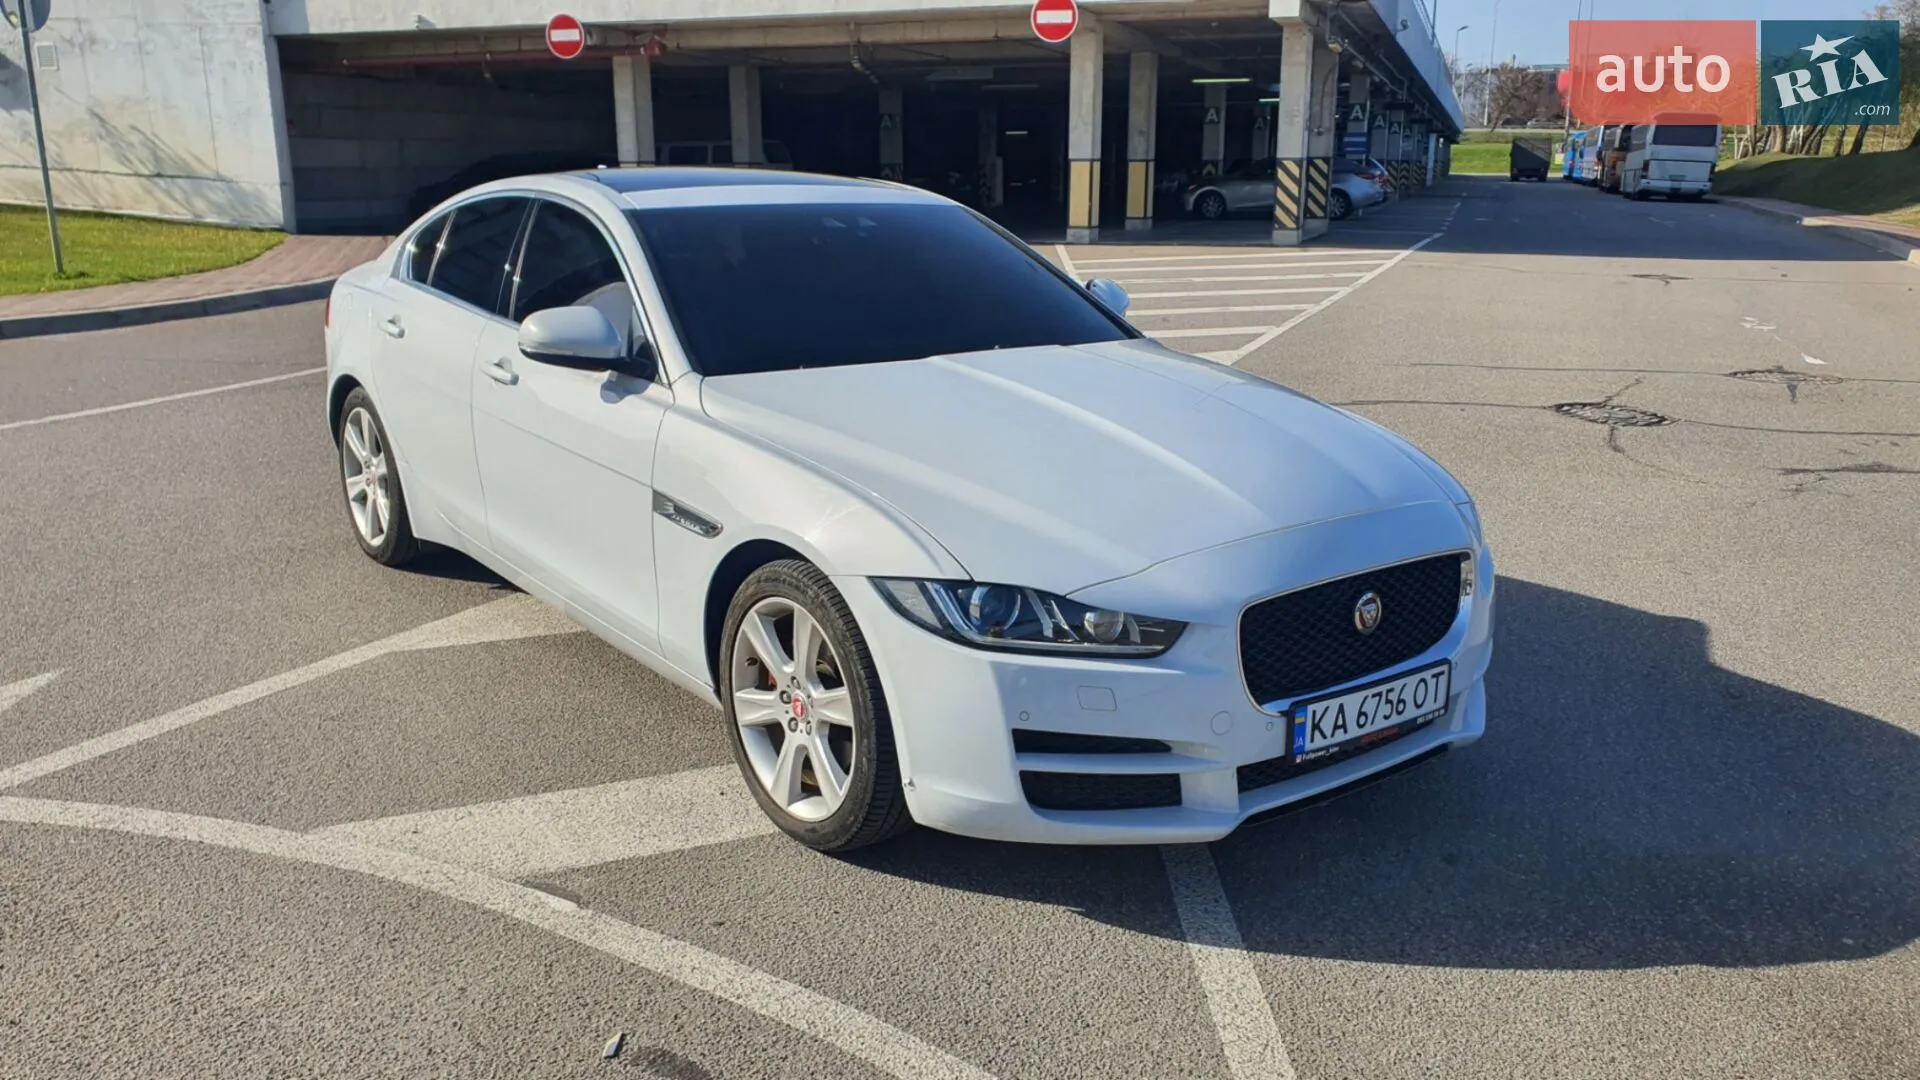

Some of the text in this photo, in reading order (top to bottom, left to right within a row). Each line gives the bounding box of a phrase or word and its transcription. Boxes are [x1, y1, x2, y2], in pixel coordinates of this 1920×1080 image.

[1206, 107, 1218, 122] A
[1350, 105, 1363, 119] A
[1254, 117, 1266, 129] A
[1374, 115, 1385, 127] A
[1390, 123, 1400, 133] A
[1310, 702, 1348, 743] KA
[1356, 682, 1408, 729] 6756
[1413, 670, 1445, 709] OT
